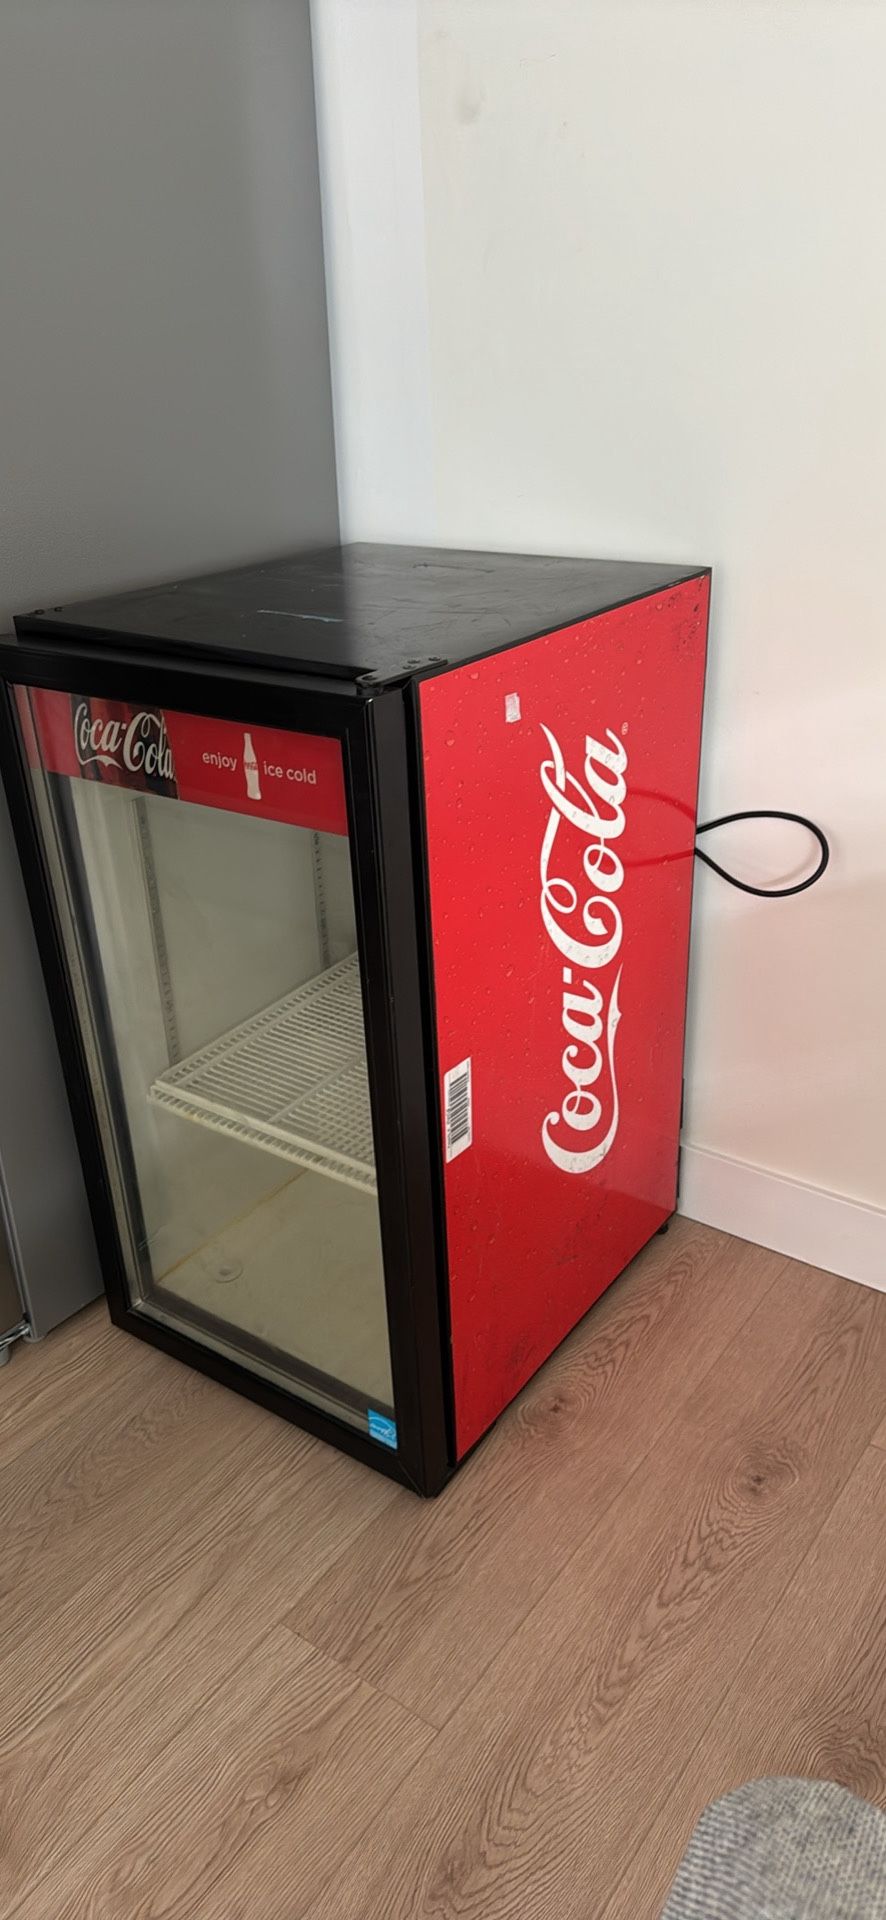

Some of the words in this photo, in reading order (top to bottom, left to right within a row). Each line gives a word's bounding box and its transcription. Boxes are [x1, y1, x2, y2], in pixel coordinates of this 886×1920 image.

[75, 702, 175, 781] Coca-Cola
[202, 752, 237, 772] enjoy
[263, 761, 283, 778] ice
[286, 768, 317, 785] cold
[540, 722, 628, 1174] Coca-Cola
